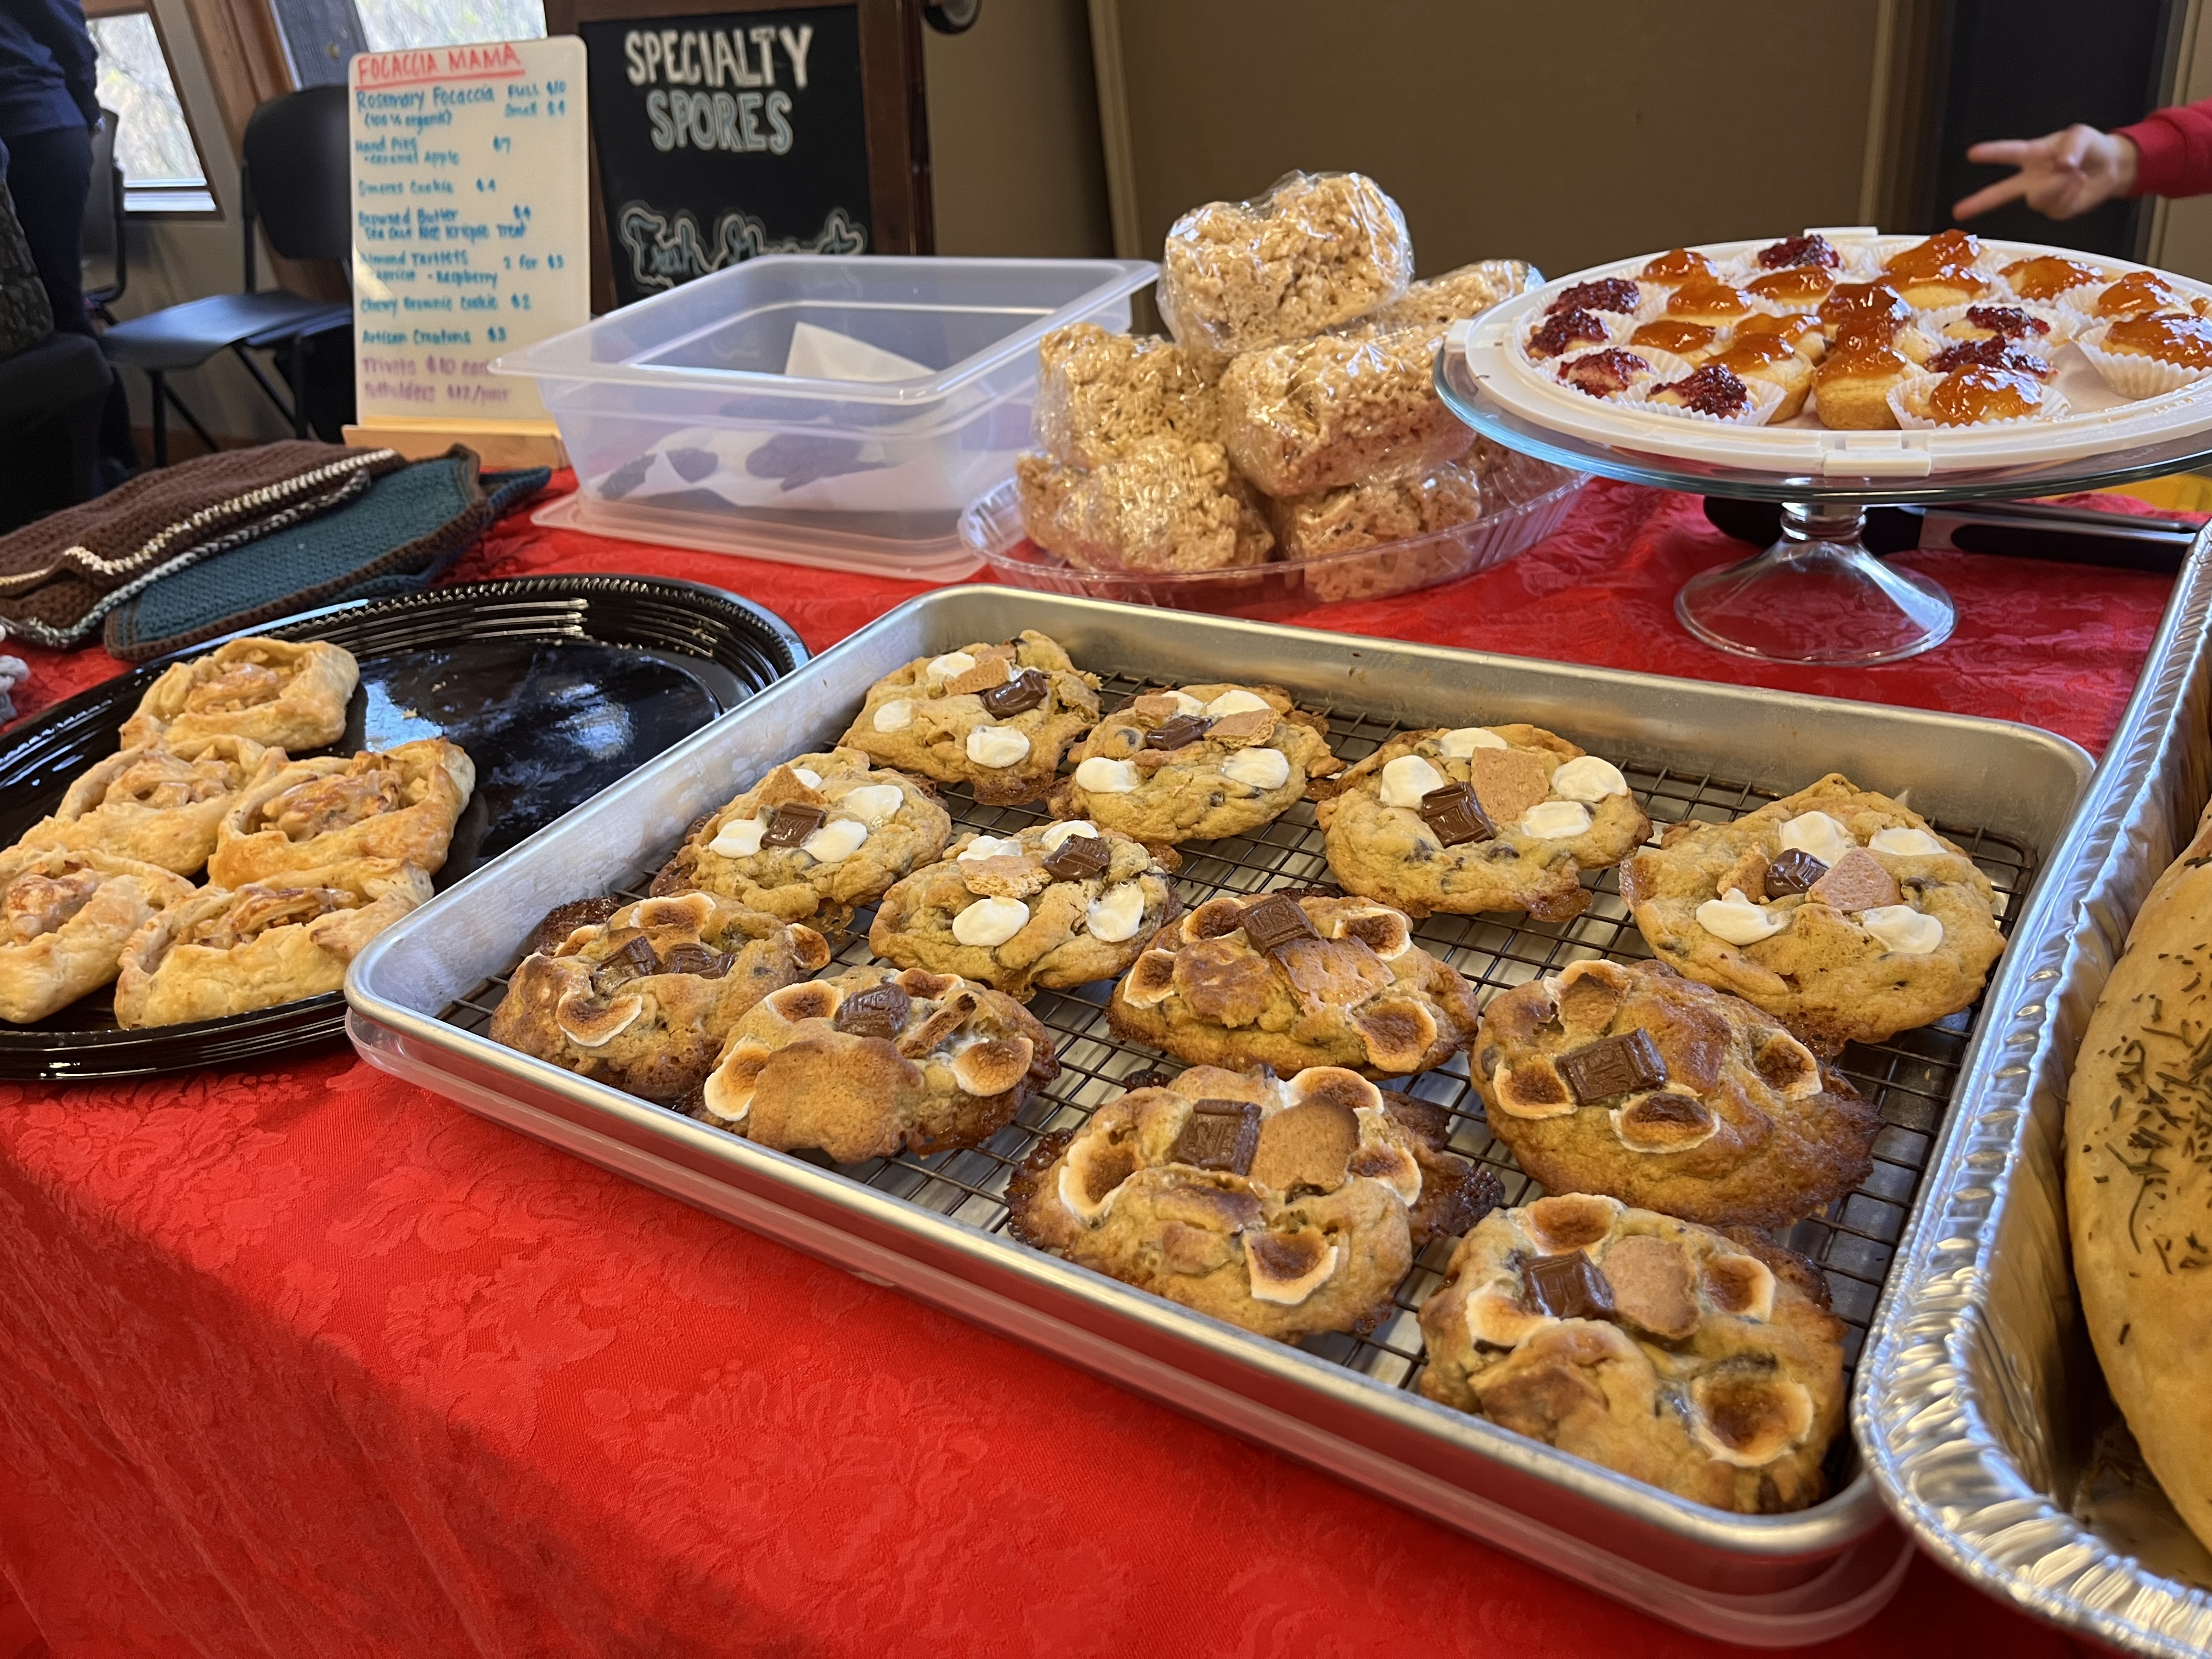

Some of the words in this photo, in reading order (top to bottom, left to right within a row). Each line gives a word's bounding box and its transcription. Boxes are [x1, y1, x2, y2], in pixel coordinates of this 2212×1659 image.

[358, 52, 438, 83] FOCACCIA
[448, 43, 522, 71] MAMA
[625, 25, 814, 89] SPECIALTY
[356, 91, 425, 112] Rosemary
[433, 84, 494, 108] Focaccia
[646, 89, 794, 155] SPORES
[356, 136, 385, 152] Hand
[493, 136, 511, 154] $7
[410, 179, 454, 194] Cookie
[417, 207, 458, 224] Butter
[519, 254, 538, 269] for
